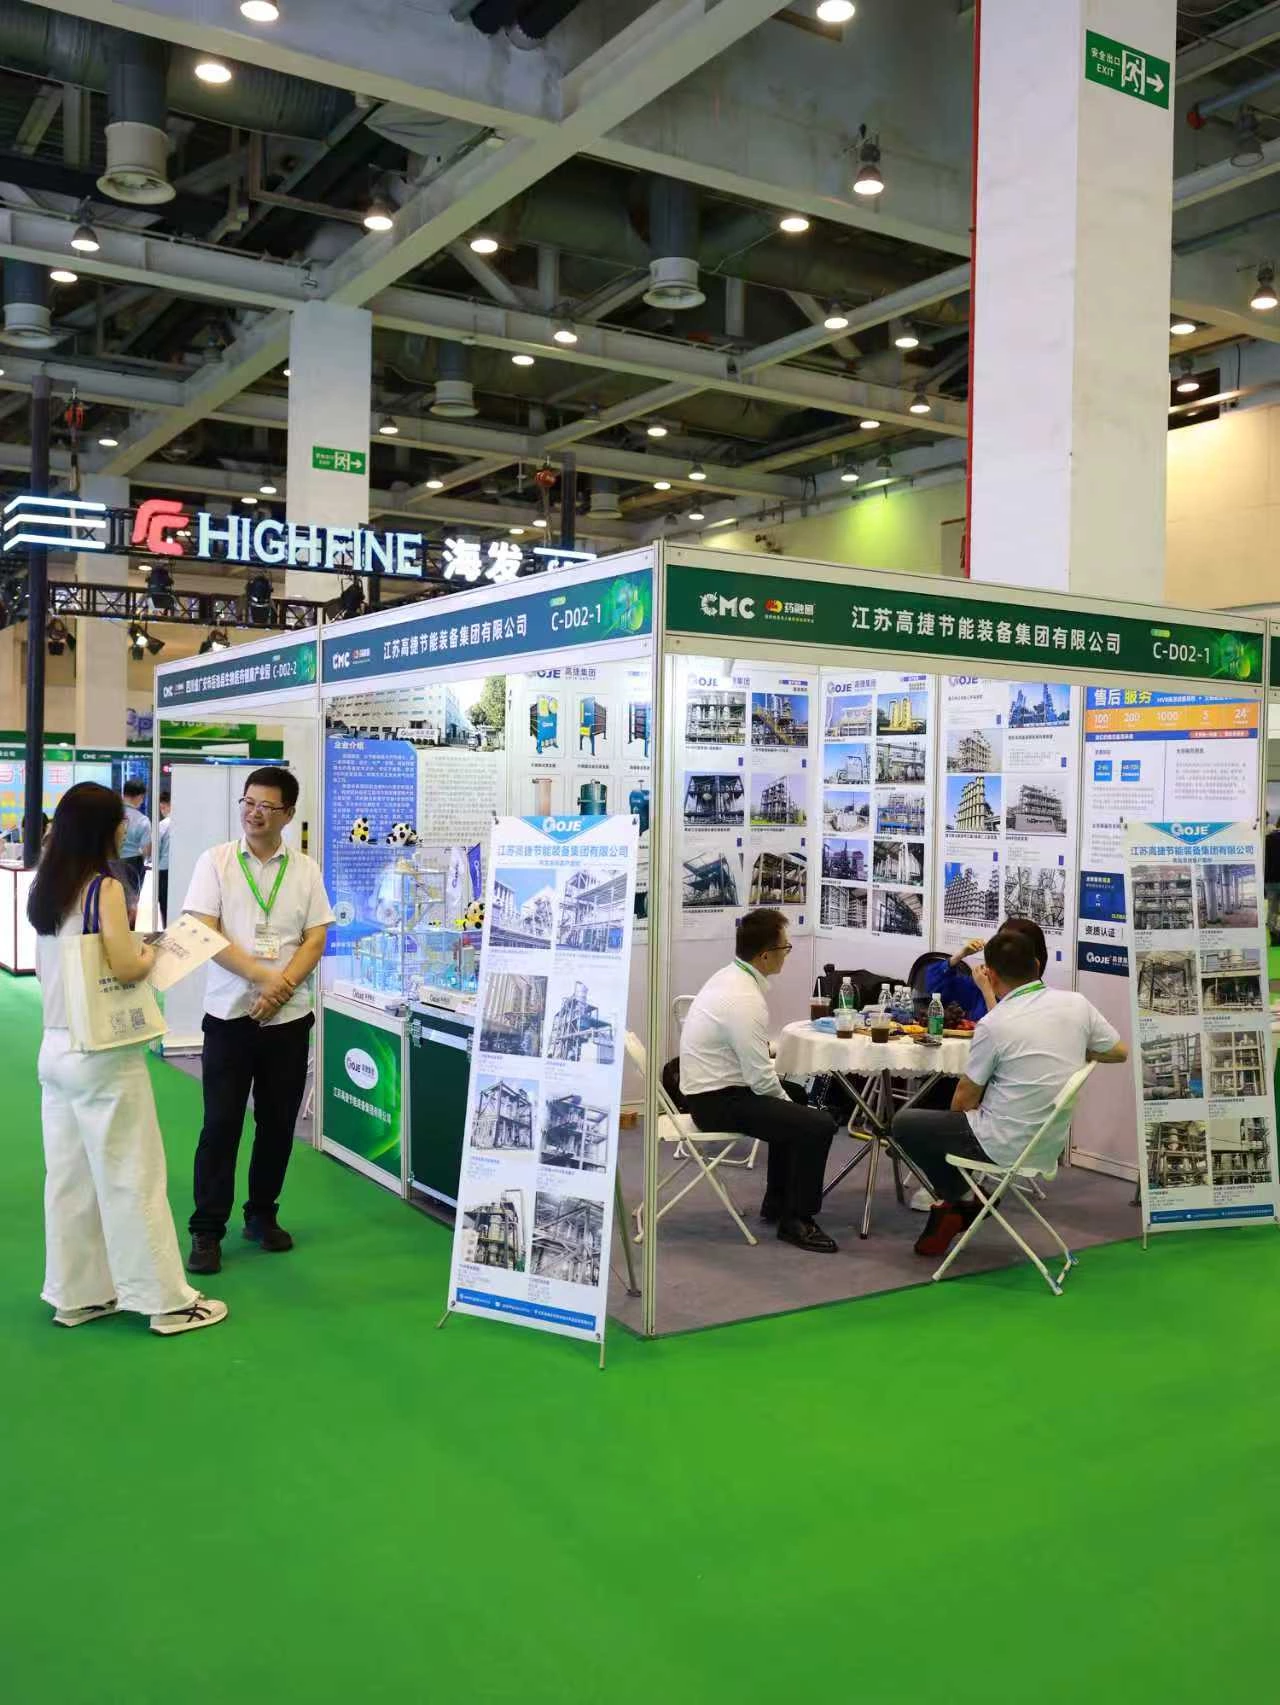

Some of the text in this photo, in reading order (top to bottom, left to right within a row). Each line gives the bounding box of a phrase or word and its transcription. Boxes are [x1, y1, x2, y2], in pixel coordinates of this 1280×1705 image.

[1091, 47, 1120, 66] 安全出口
[1096, 63, 1115, 77] EXIT
[197, 511, 524, 584] HIGHFINE 海发
[700, 592, 755, 619] CMC
[851, 605, 1121, 654] 江苏高捷节能装备集团有限公司
[1153, 641, 1210, 664] C-D02-1
[332, 651, 350, 670] CMC
[383, 613, 528, 660] 江苏高捷节能装备集团有限公司
[551, 605, 601, 632] C-D02-1
[272, 661, 297, 678] C-D02-2
[565, 667, 596, 677] 高捷集团
[543, 817, 582, 832] GOJE
[1171, 823, 1208, 836] GOJE
[498, 845, 628, 857] 江苏高捷节能装备集团有限公司
[1131, 845, 1254, 856] 江苏高捷节能装备集团有限公司
[1085, 925, 1116, 938] 资质认证
[1086, 952, 1110, 965] GOJE
